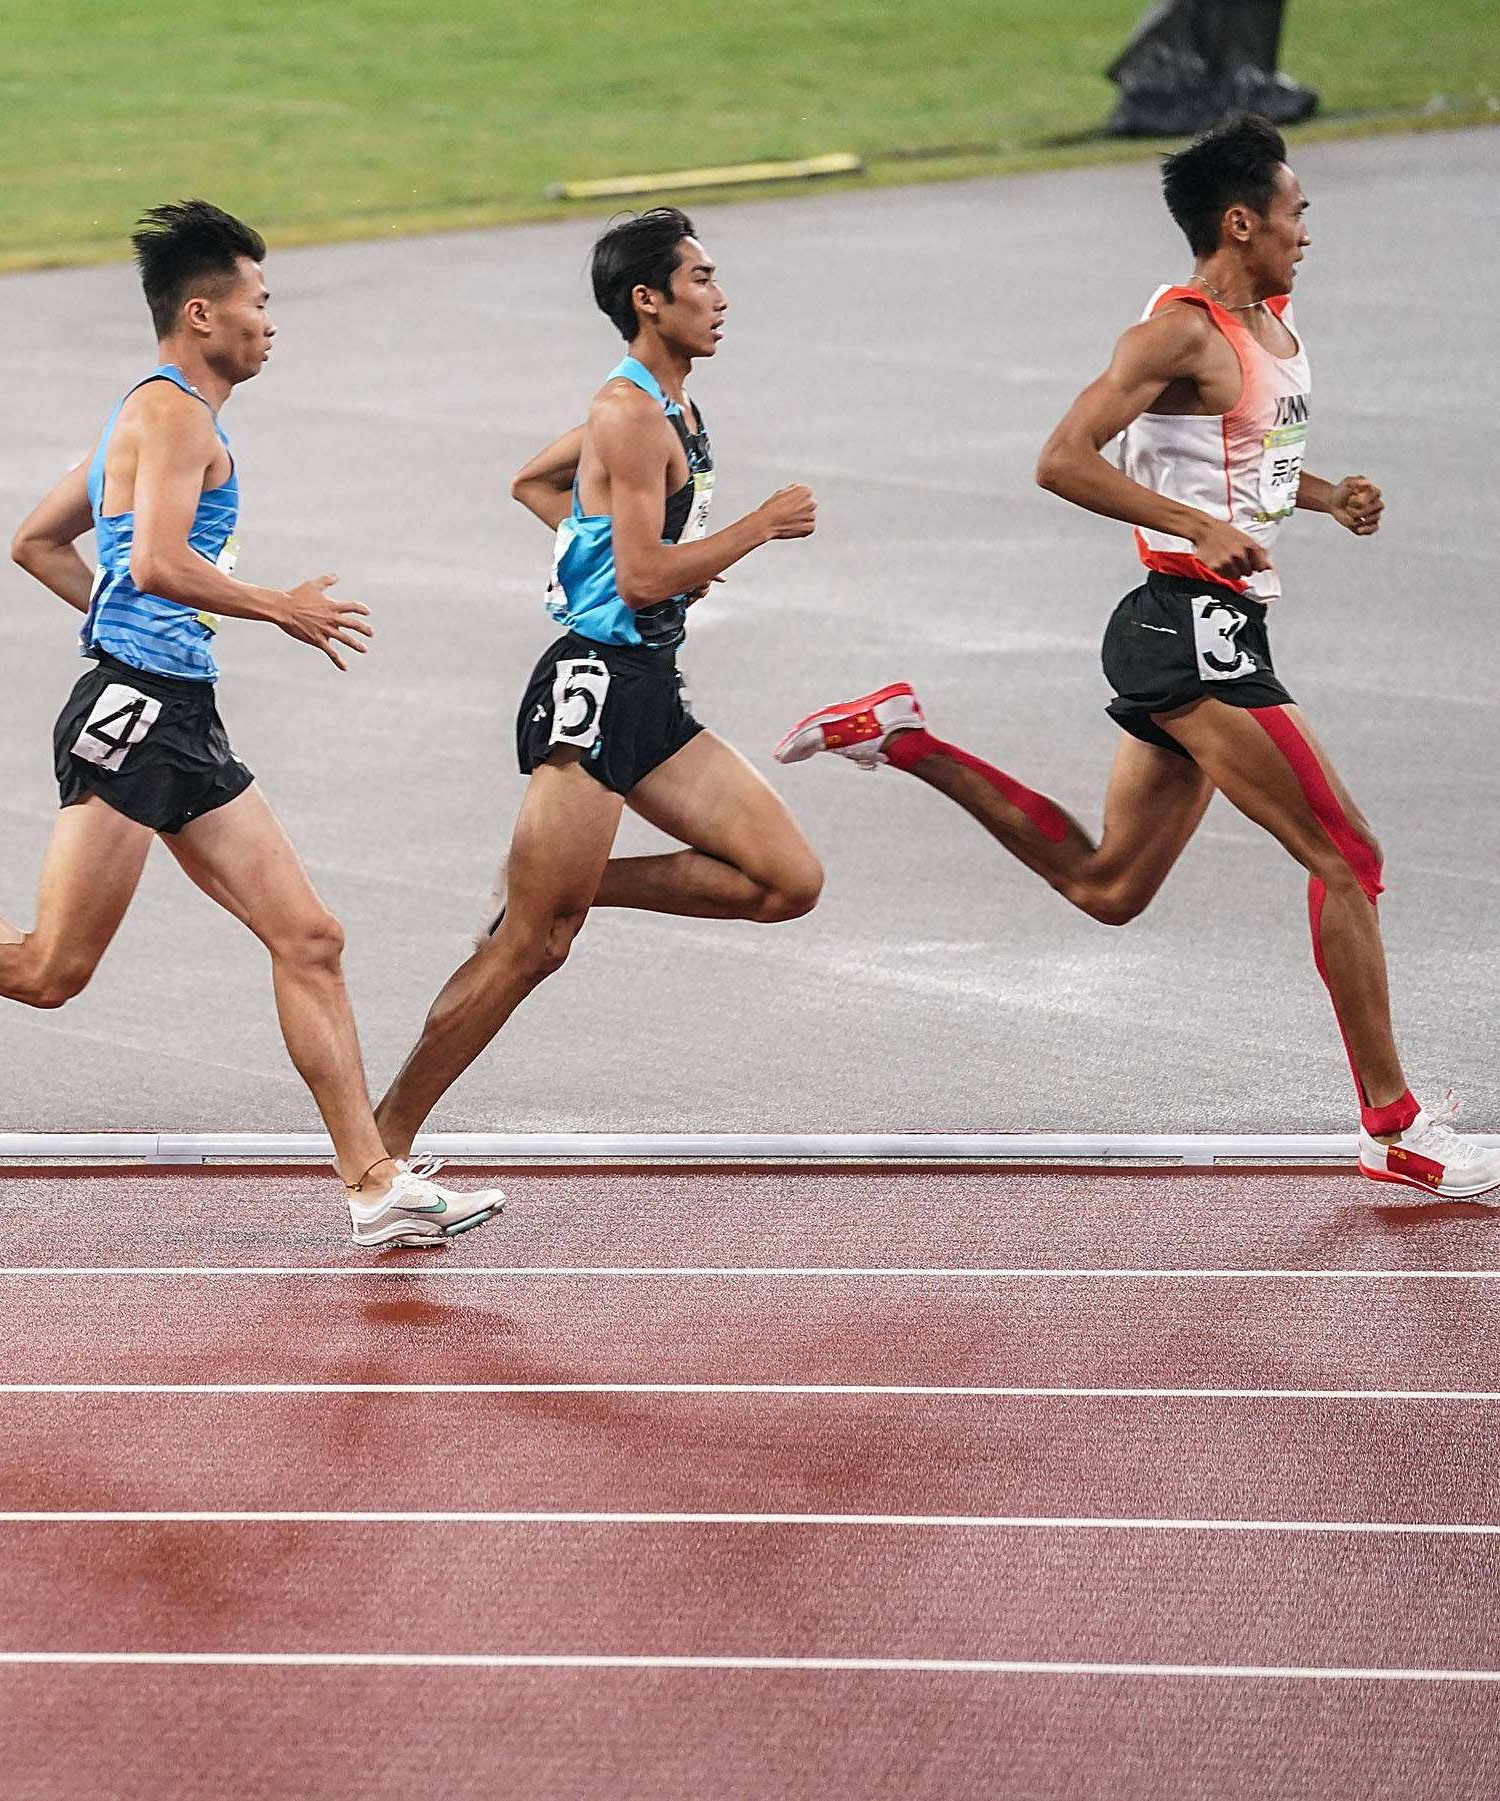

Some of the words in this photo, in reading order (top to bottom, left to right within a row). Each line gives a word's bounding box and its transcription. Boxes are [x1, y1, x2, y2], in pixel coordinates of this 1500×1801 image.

[1201, 601, 1241, 673] 3
[86, 698, 147, 760] 4
[560, 664, 602, 737] 5
